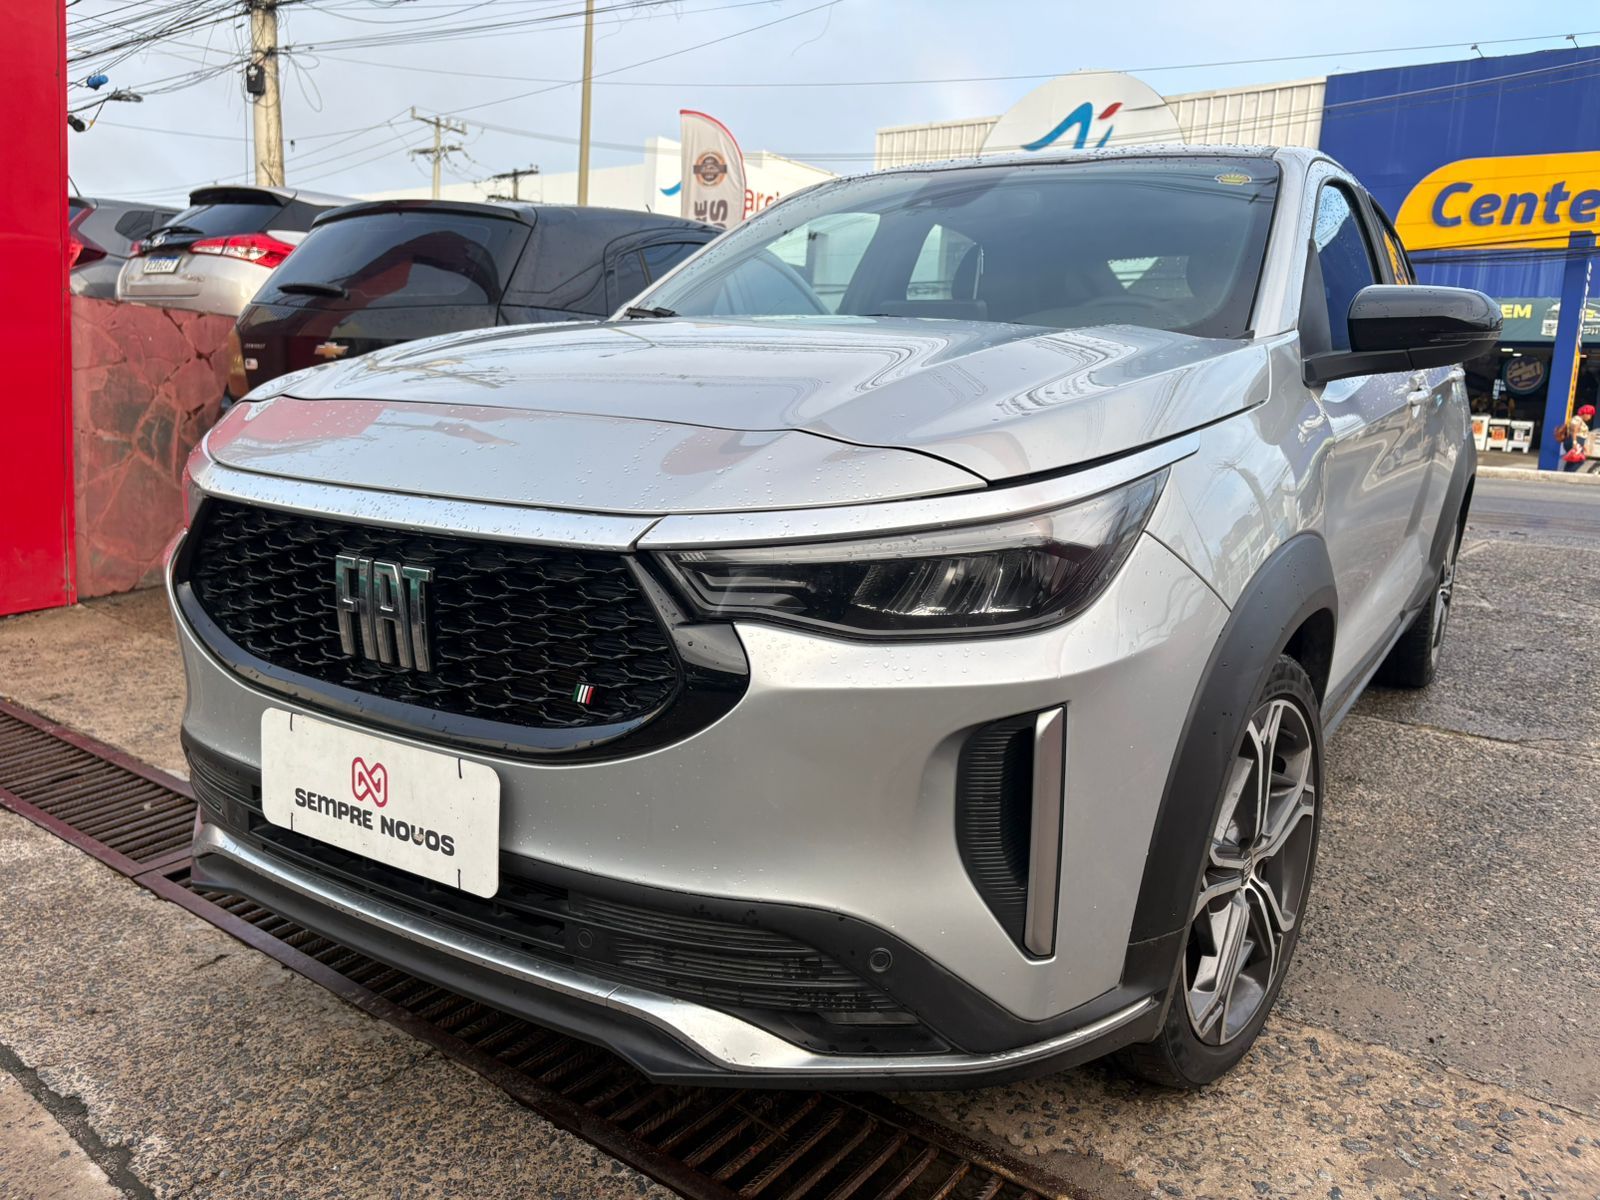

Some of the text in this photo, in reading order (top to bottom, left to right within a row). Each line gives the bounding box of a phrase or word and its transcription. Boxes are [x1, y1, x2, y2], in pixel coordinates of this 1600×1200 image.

[1432, 181, 1600, 227] Cente
[336, 554, 434, 673] FIAT
[295, 787, 374, 831] SEMPRE
